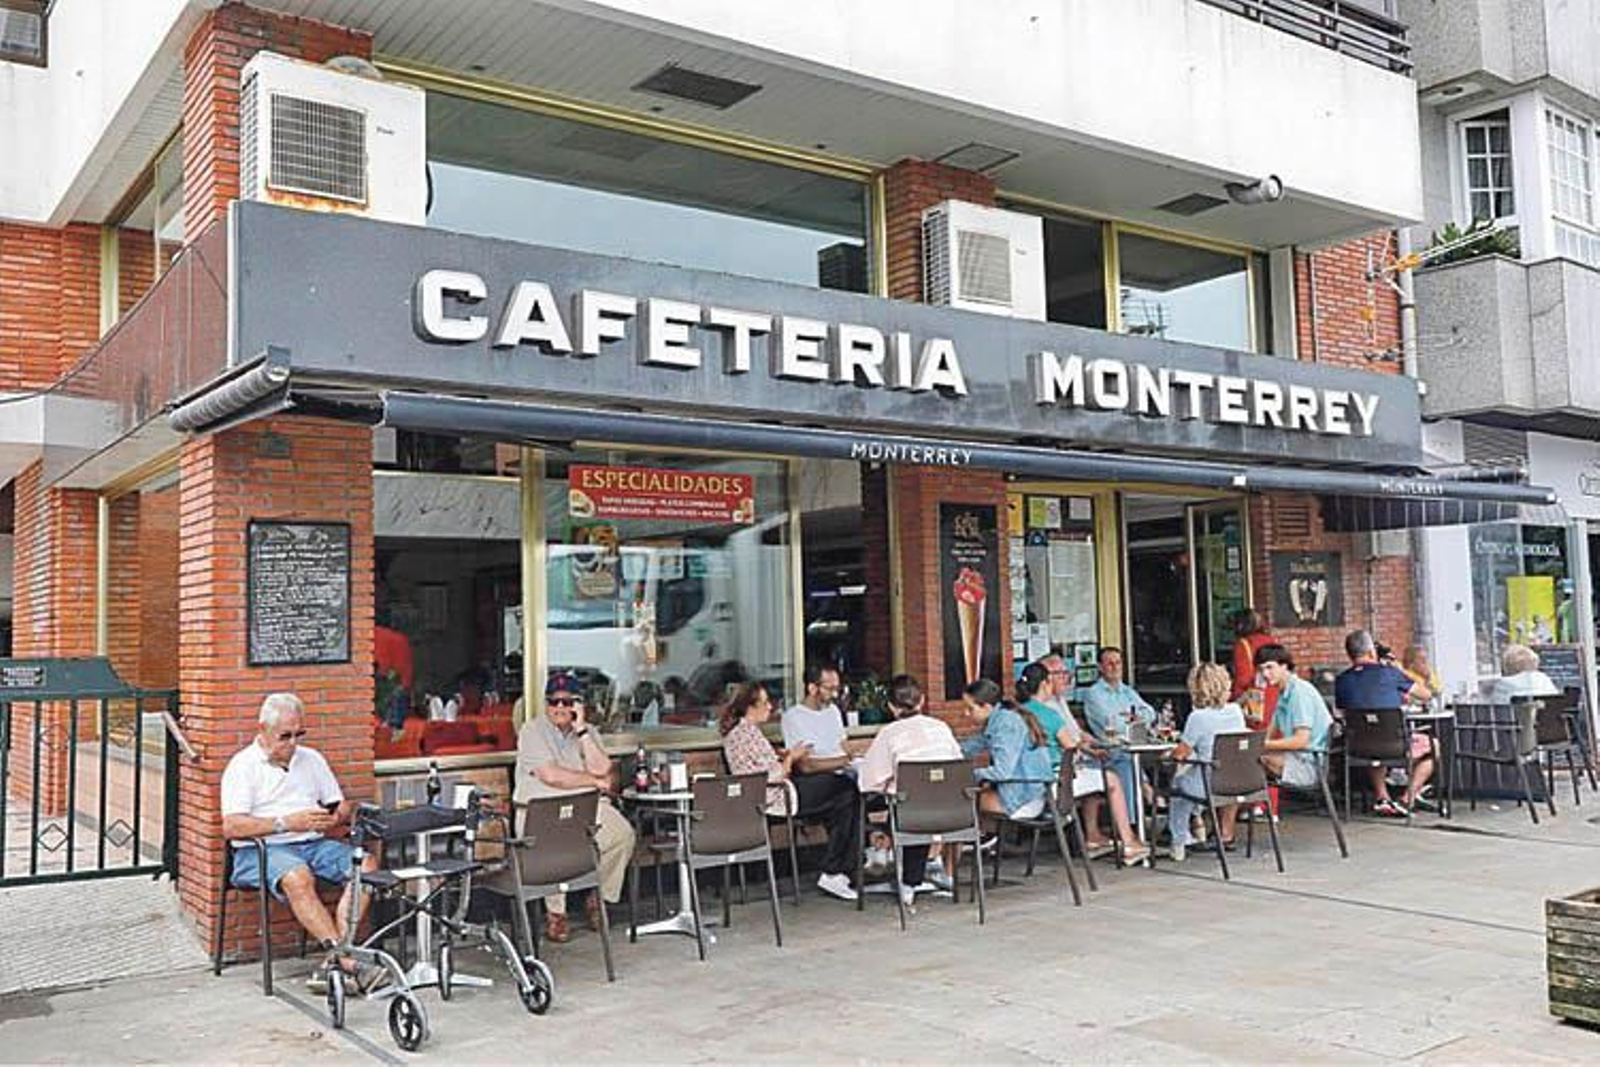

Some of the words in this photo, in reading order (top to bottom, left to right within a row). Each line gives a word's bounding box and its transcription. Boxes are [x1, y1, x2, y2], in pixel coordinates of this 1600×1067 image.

[415, 268, 968, 397] CAFETERIA
[1037, 351, 1380, 437] MONTERREY
[851, 441, 972, 465] MONTERREY
[582, 469, 743, 495] ESPECIALIDADES
